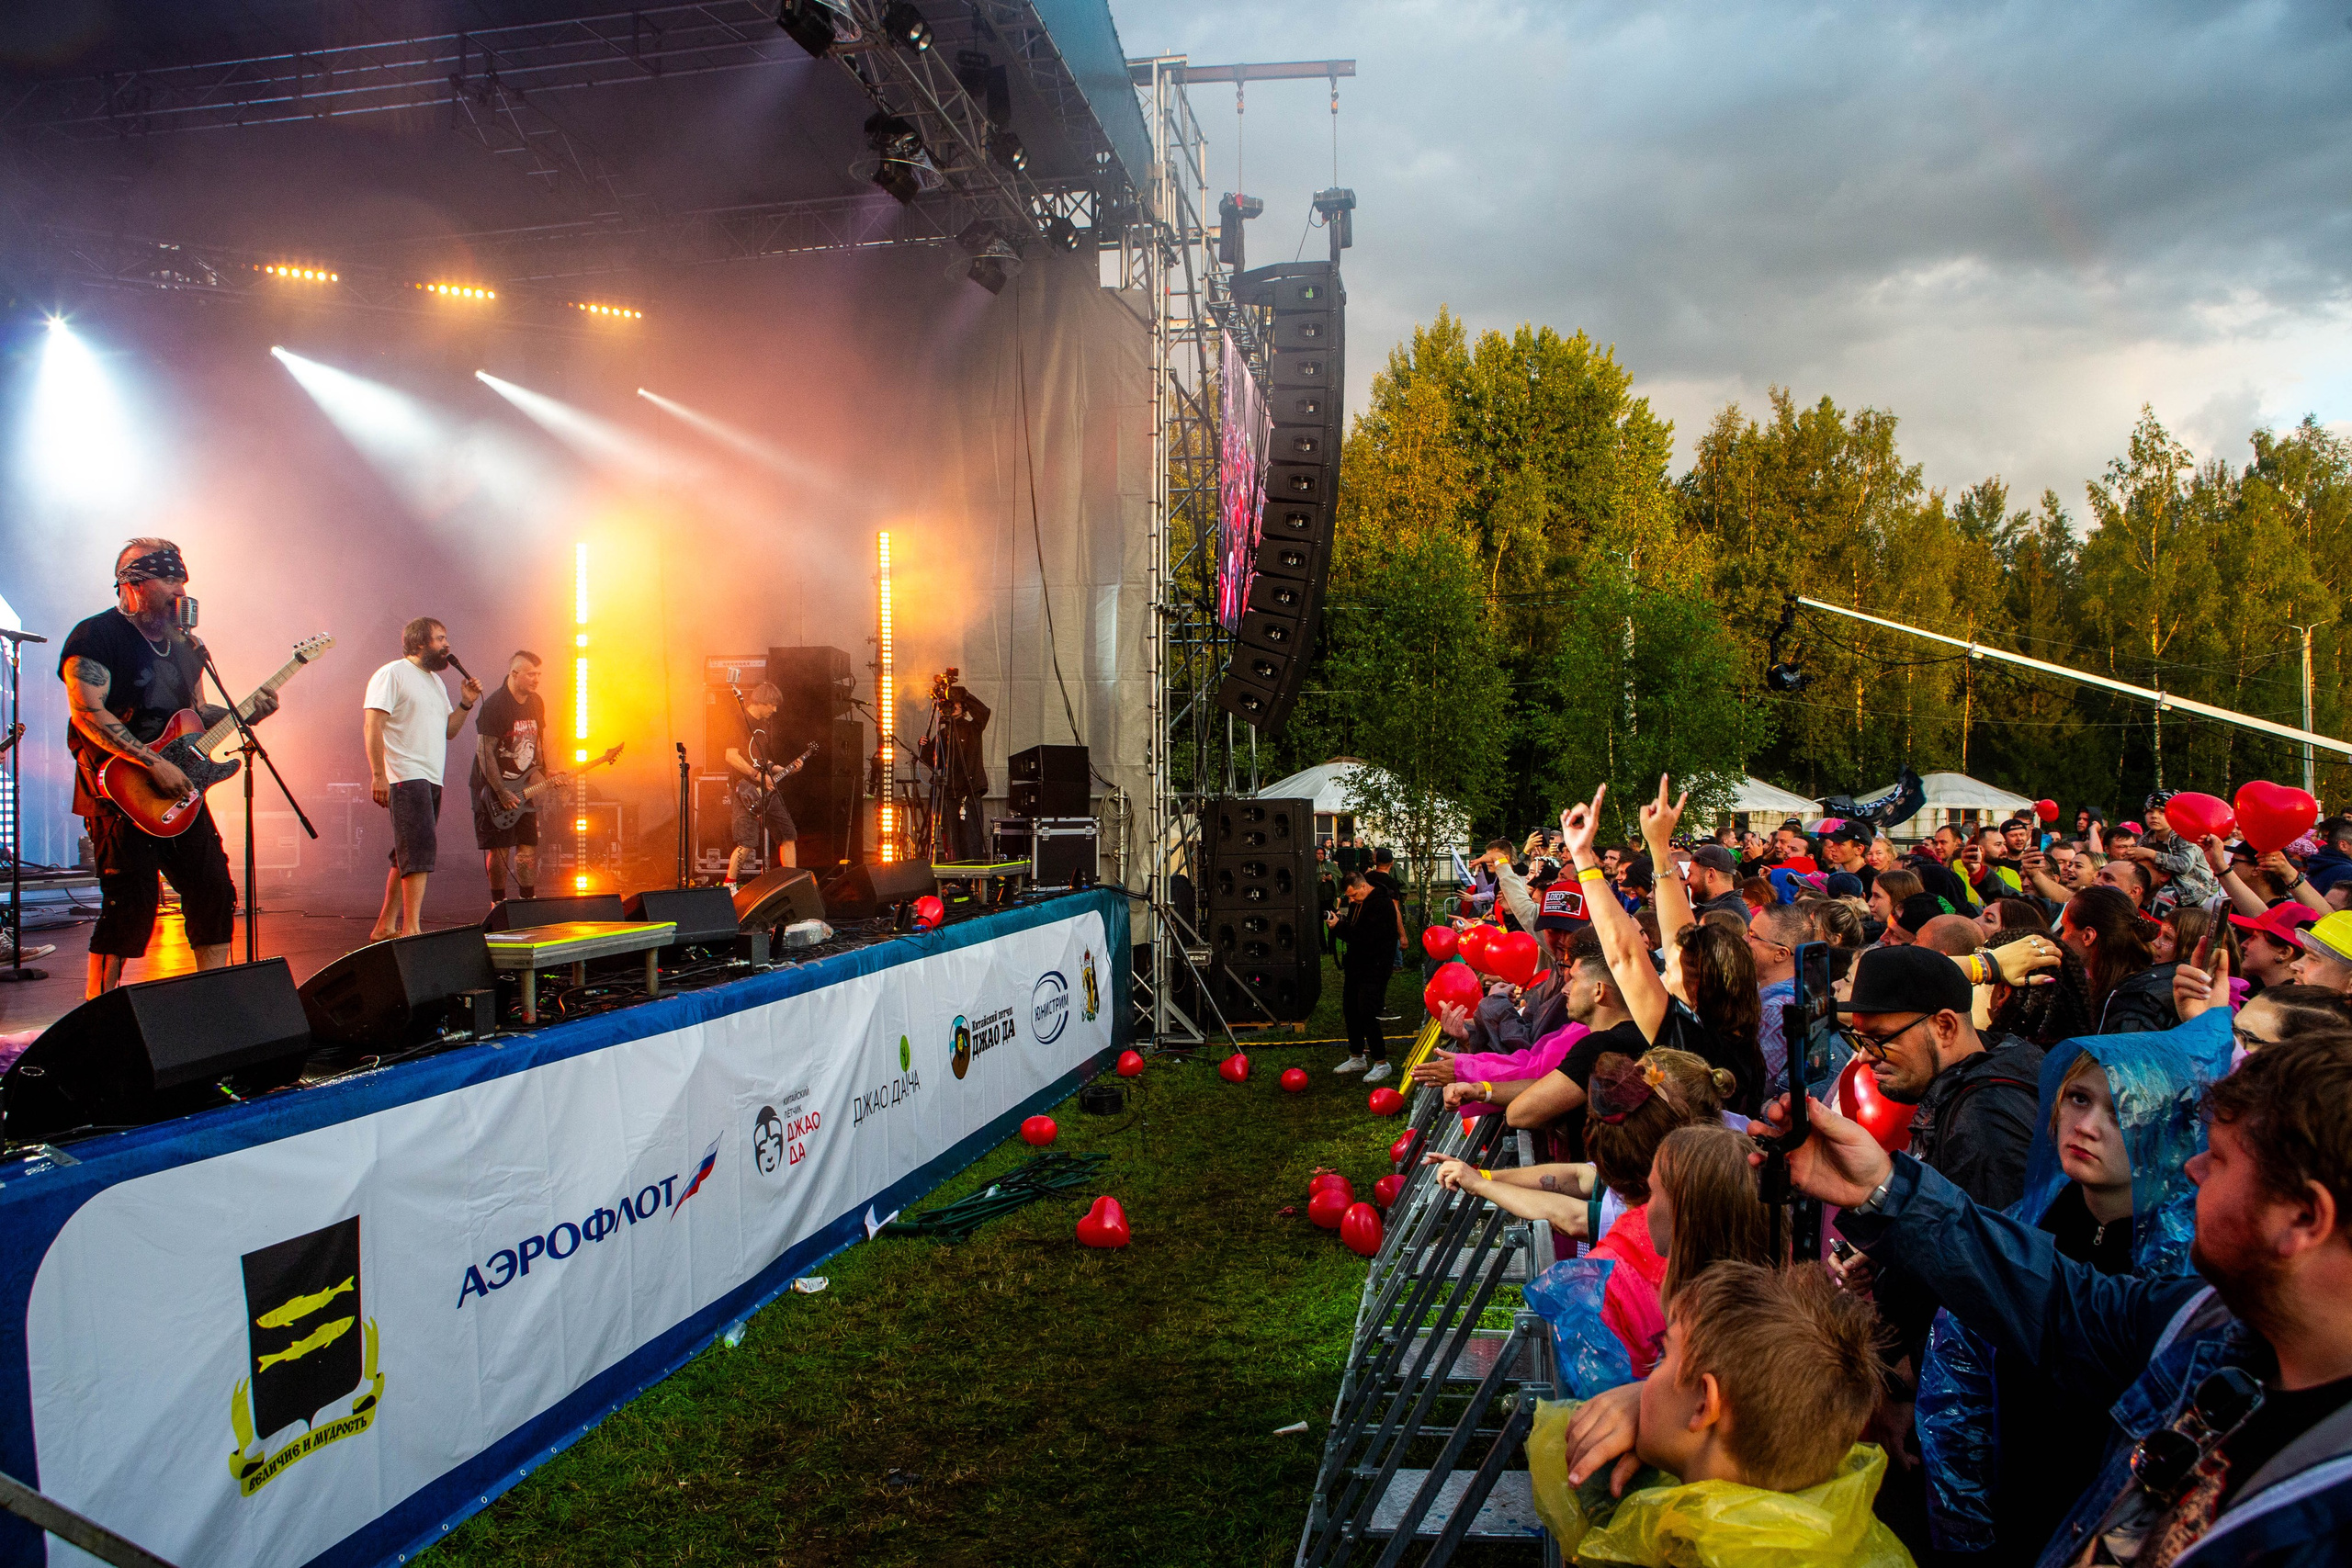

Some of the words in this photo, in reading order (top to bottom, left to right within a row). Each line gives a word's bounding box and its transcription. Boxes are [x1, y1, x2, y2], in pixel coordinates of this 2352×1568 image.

[1035, 993, 1069, 1022] ЮНИСТРИМ
[971, 1024, 1001, 1061] ДЖАО
[1002, 1018, 1016, 1046] ДА
[783, 1086, 810, 1106] КИТАЙСКИЙ
[854, 1085, 888, 1128] ДЖАО
[787, 1111, 821, 1143] ДЖАО
[789, 1142, 807, 1166] ДА
[456, 1173, 679, 1310] АЭРОФЛОТ
[247, 1444, 301, 1493] ВЕЛИЧИЕ
[302, 1436, 312, 1453] И
[312, 1416, 368, 1445] МУДРОСТЬ
